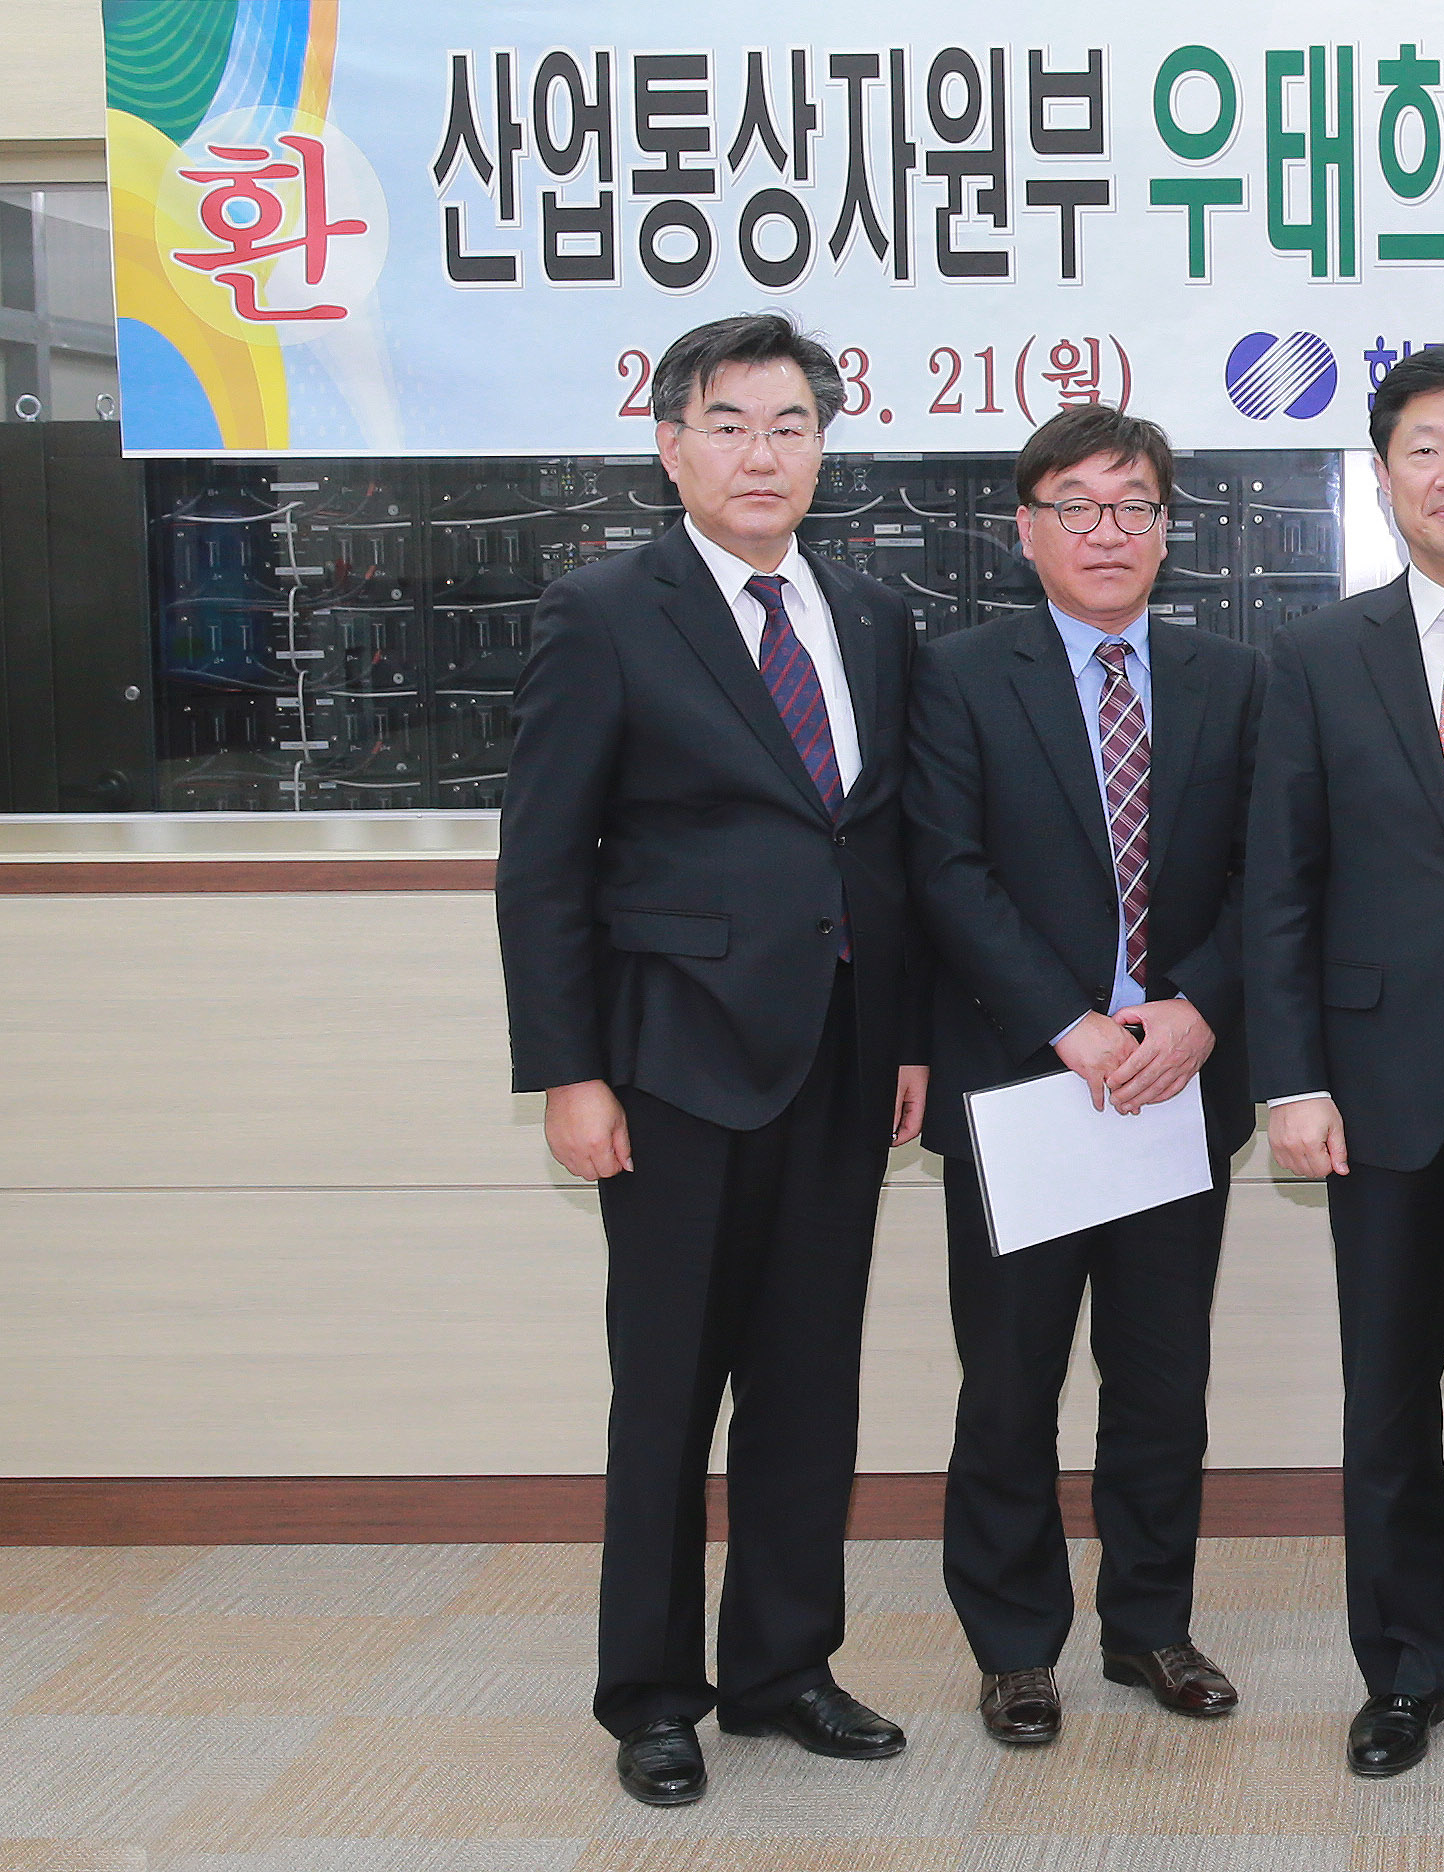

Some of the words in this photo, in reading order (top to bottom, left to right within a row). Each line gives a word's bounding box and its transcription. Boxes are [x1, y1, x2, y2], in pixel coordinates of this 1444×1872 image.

[173, 135, 367, 322] 환
[432, 44, 1111, 289] 산업통상자원부
[929, 333, 1132, 428] 21(월)
